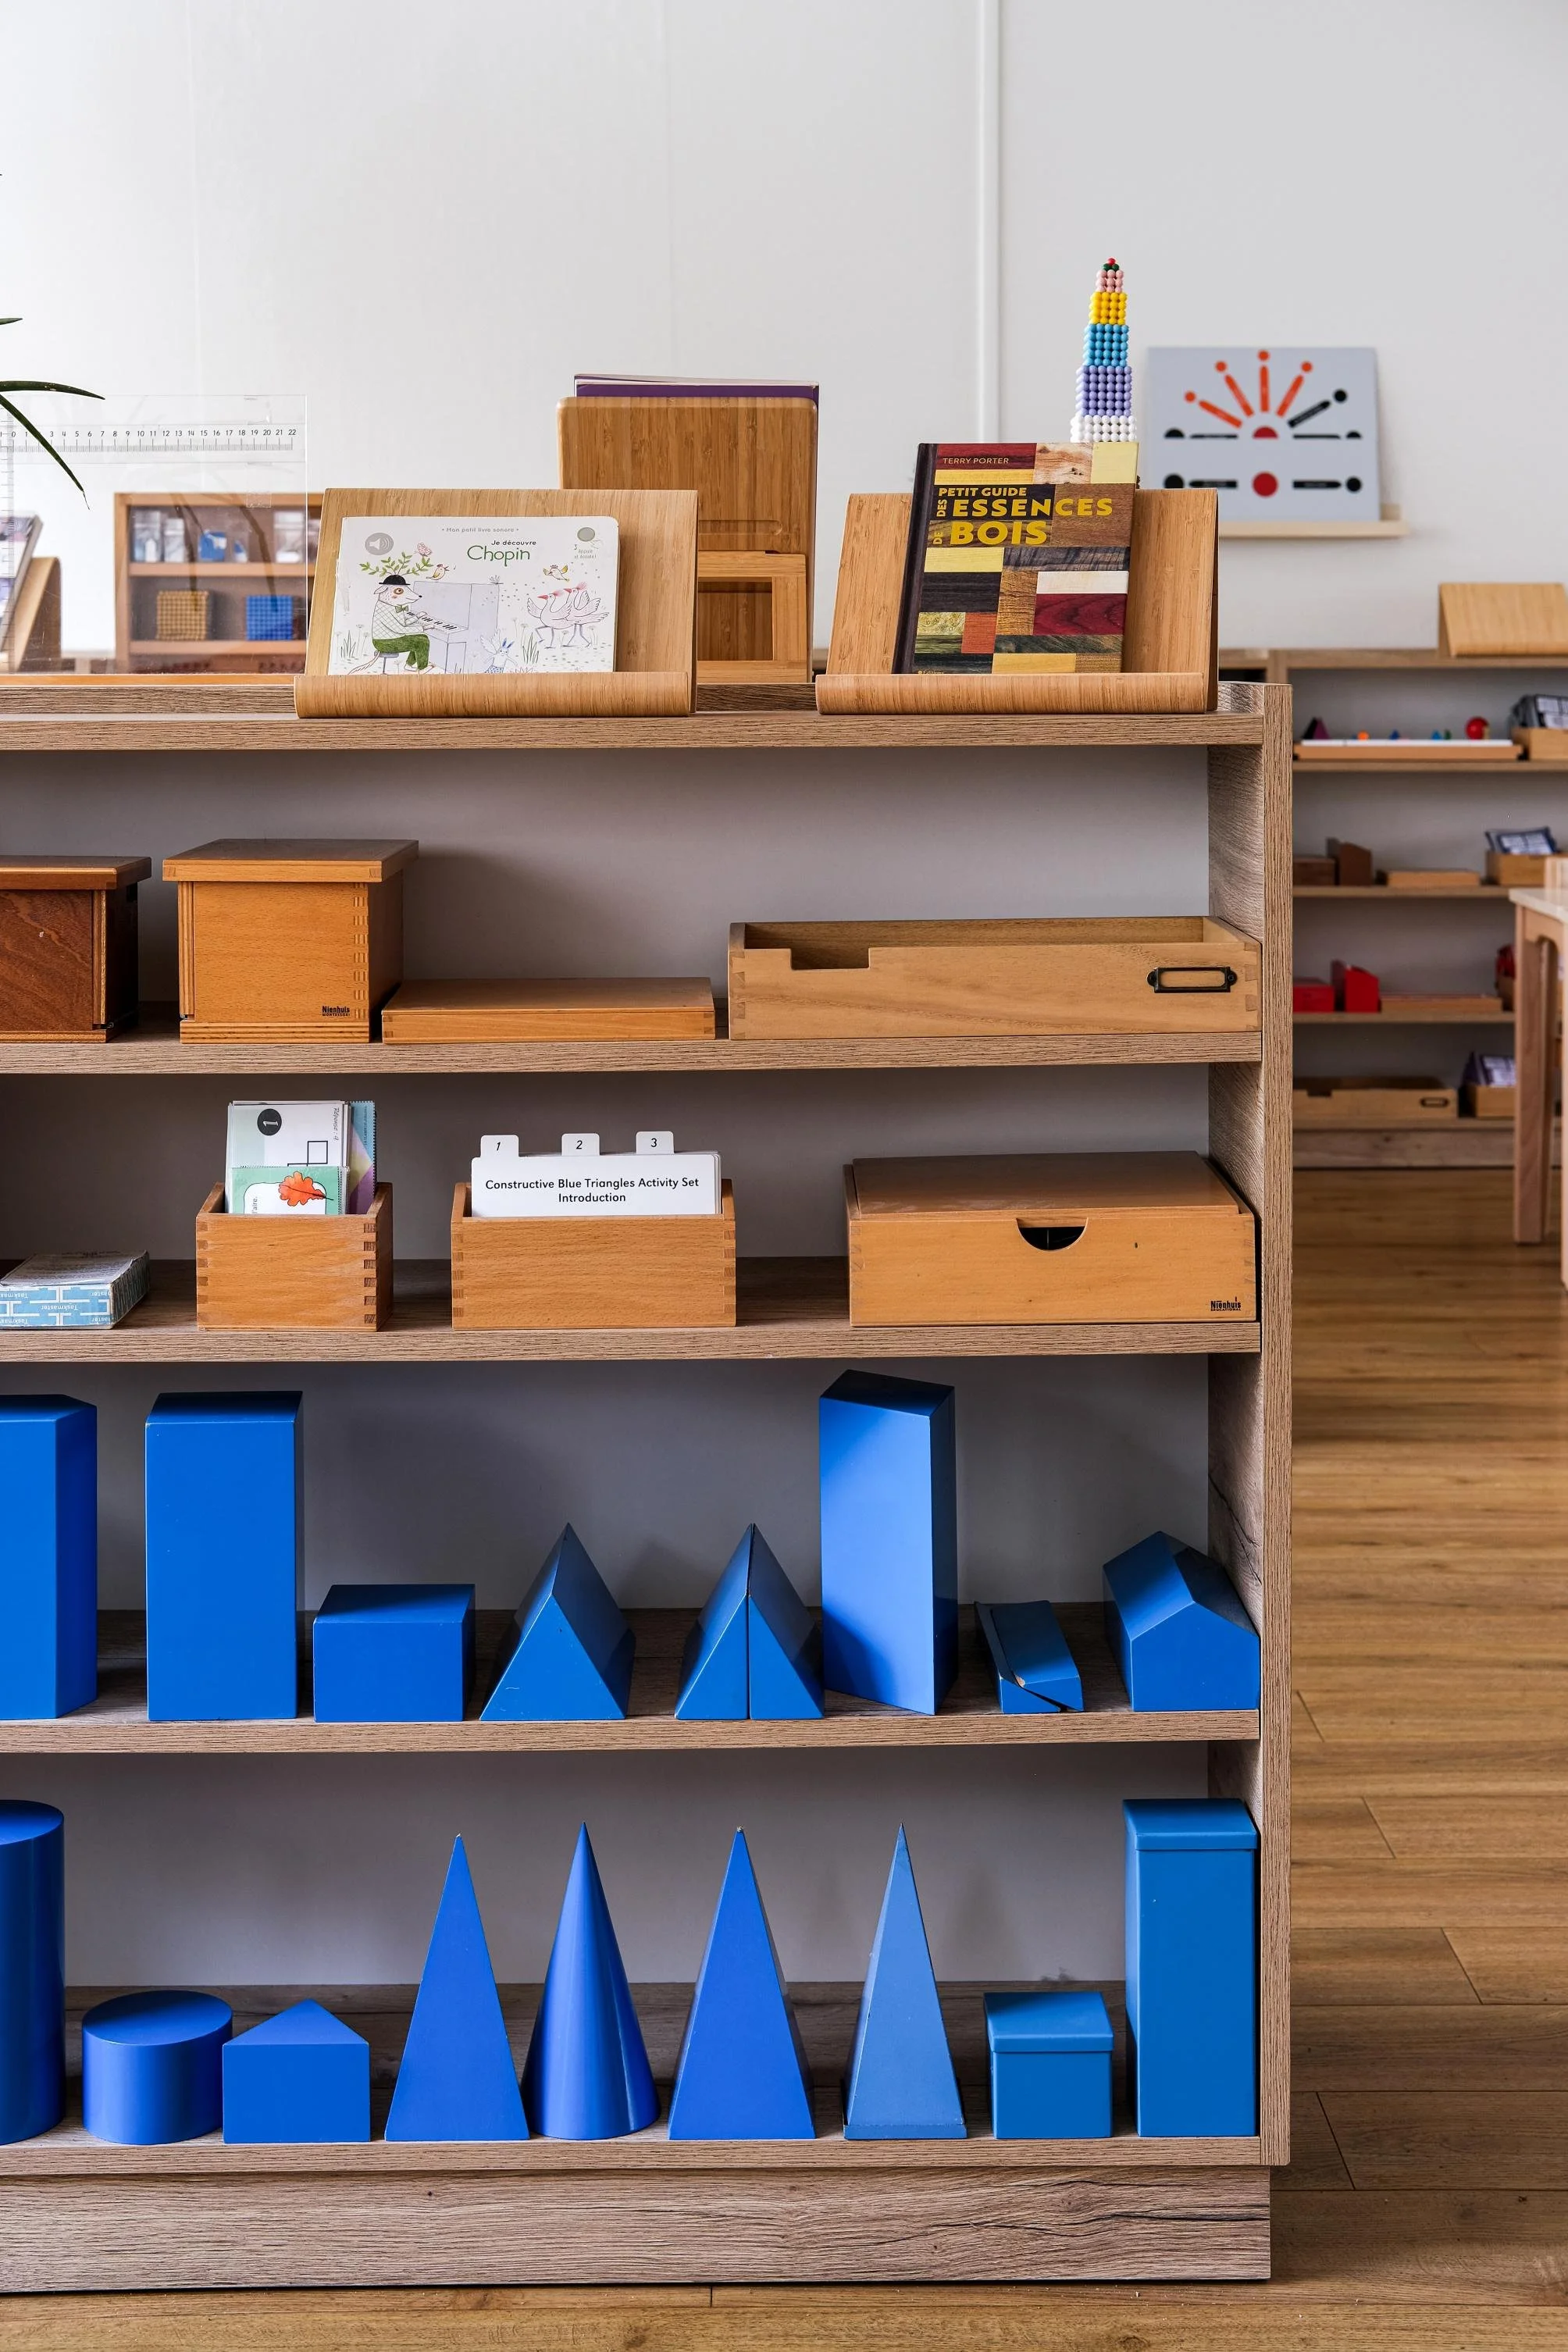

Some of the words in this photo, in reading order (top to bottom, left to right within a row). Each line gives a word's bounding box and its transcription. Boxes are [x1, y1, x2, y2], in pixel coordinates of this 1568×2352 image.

[939, 487, 980, 497] PETIT
[981, 487, 1027, 497] GUIDE
[936, 499, 947, 517] DES
[953, 497, 1113, 517] ESSENCES
[932, 531, 943, 545] DE
[950, 521, 1047, 545] BOIS
[467, 545, 530, 567] Chopin
[496, 1142, 501, 1151] 1
[576, 1140, 583, 1149] 2
[650, 1138, 657, 1148] 3
[486, 1179, 554, 1189] Constructive
[558, 1178, 582, 1188] Blue
[585, 1178, 635, 1191] Triangles
[638, 1178, 678, 1189] Activity
[682, 1177, 699, 1187] Set
[558, 1193, 625, 1203] Introduction
[1210, 1296, 1242, 1308] Nienhuis
